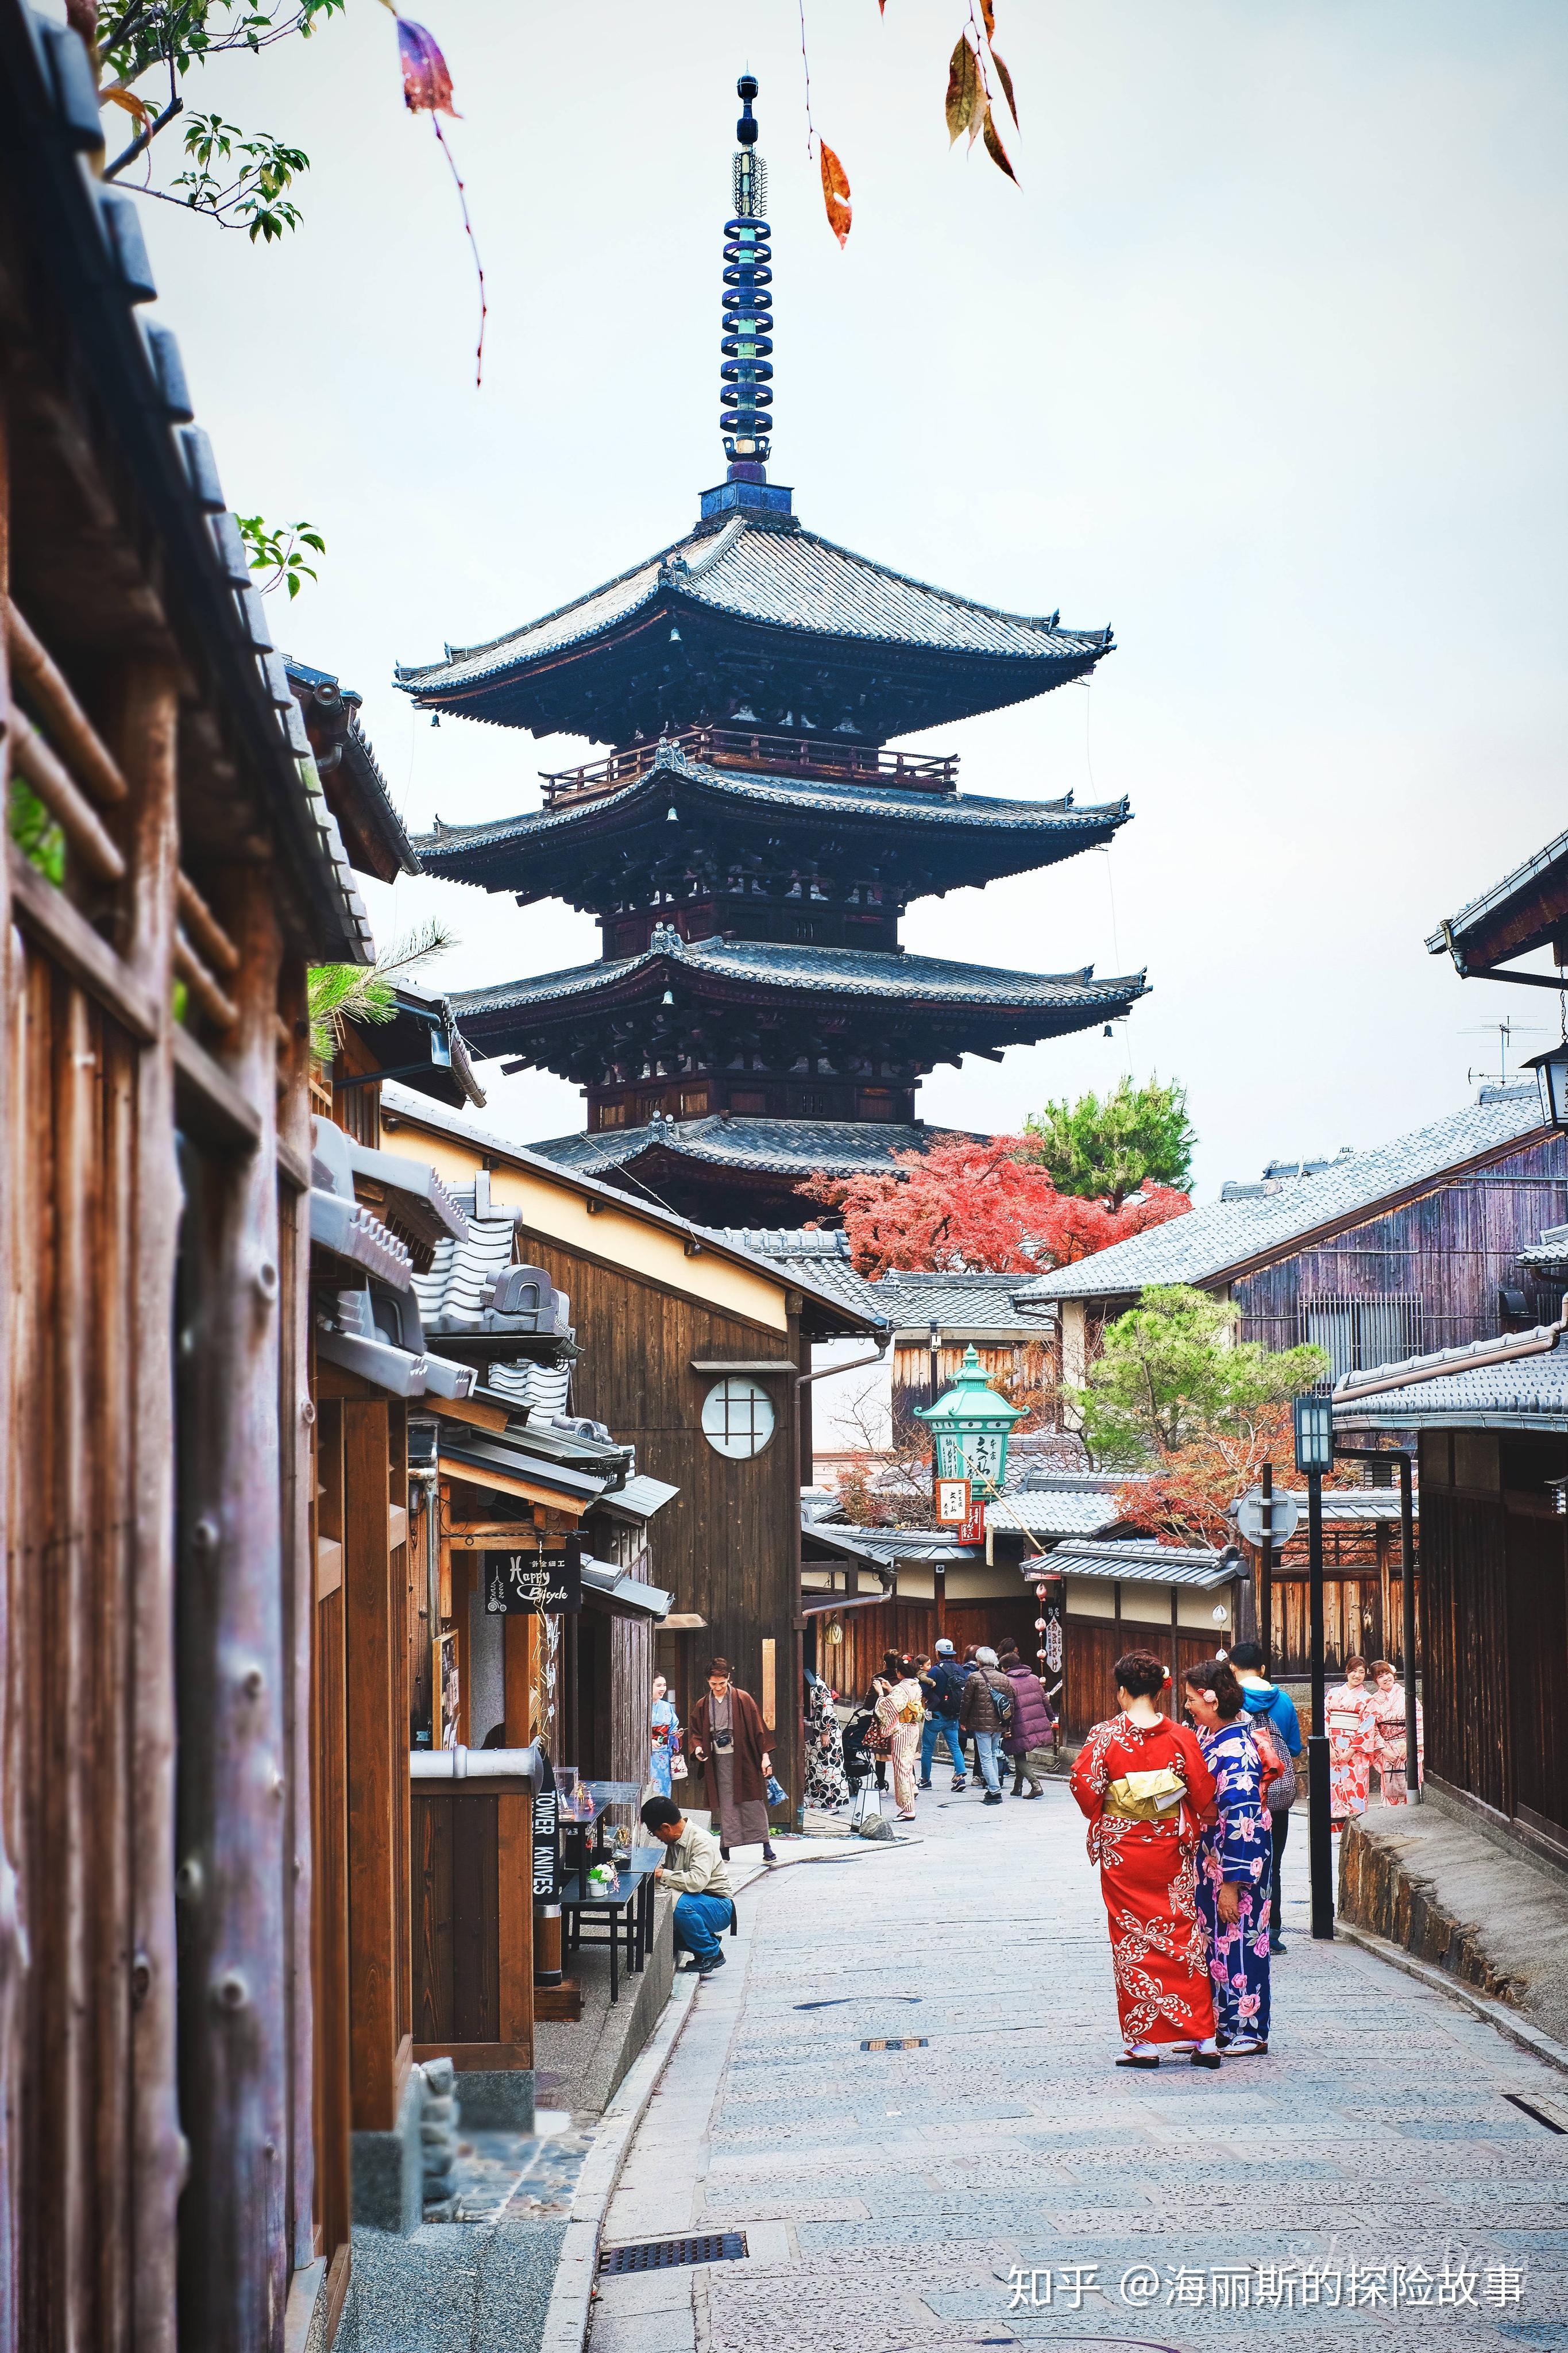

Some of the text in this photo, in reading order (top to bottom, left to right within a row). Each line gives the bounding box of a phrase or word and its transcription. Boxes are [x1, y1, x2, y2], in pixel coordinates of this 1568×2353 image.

[509, 1556, 550, 1587] Happy
[517, 1584, 569, 1604] Bicycle
[532, 1790, 556, 1895] TOWER KNIVES
